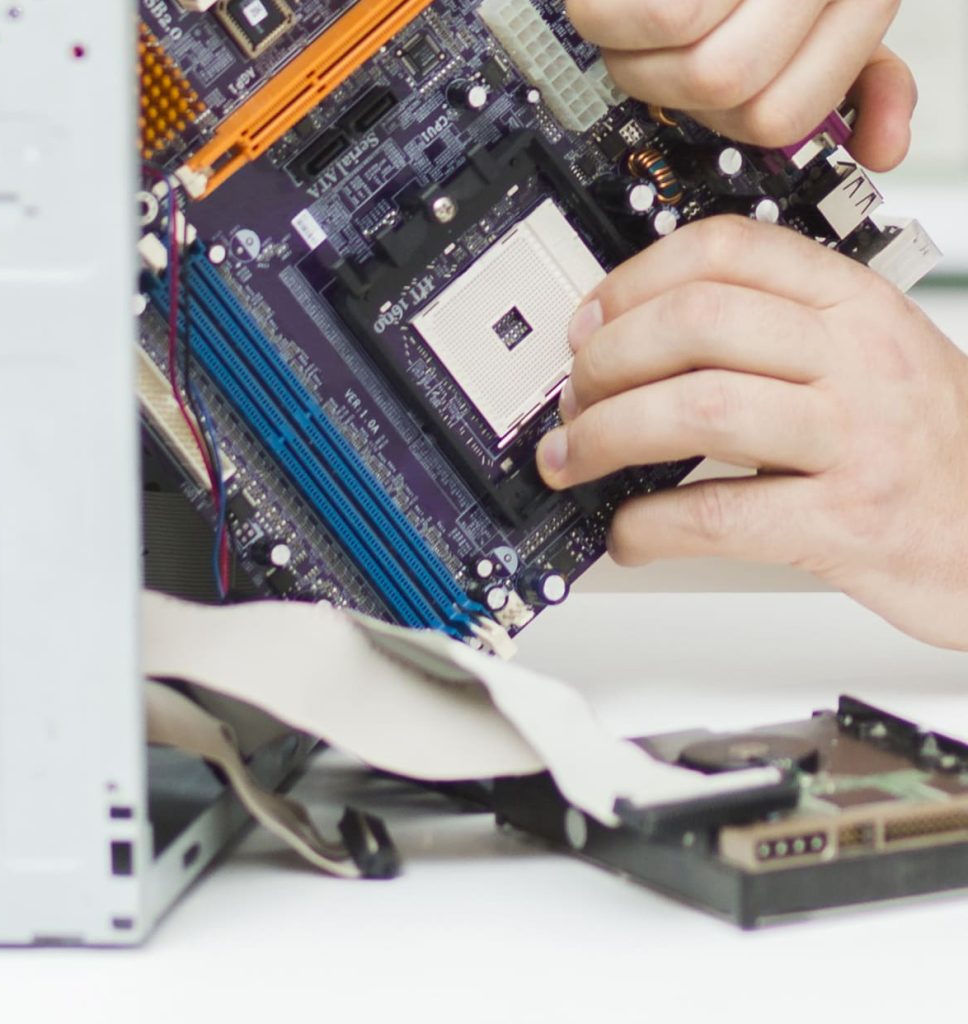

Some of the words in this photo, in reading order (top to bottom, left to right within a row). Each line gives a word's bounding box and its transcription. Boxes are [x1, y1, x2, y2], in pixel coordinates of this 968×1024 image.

[226, 65, 257, 95] AGP1
[419, 114, 449, 142] CPU1
[406, 274, 437, 306] HT
[370, 296, 411, 335] 1600
